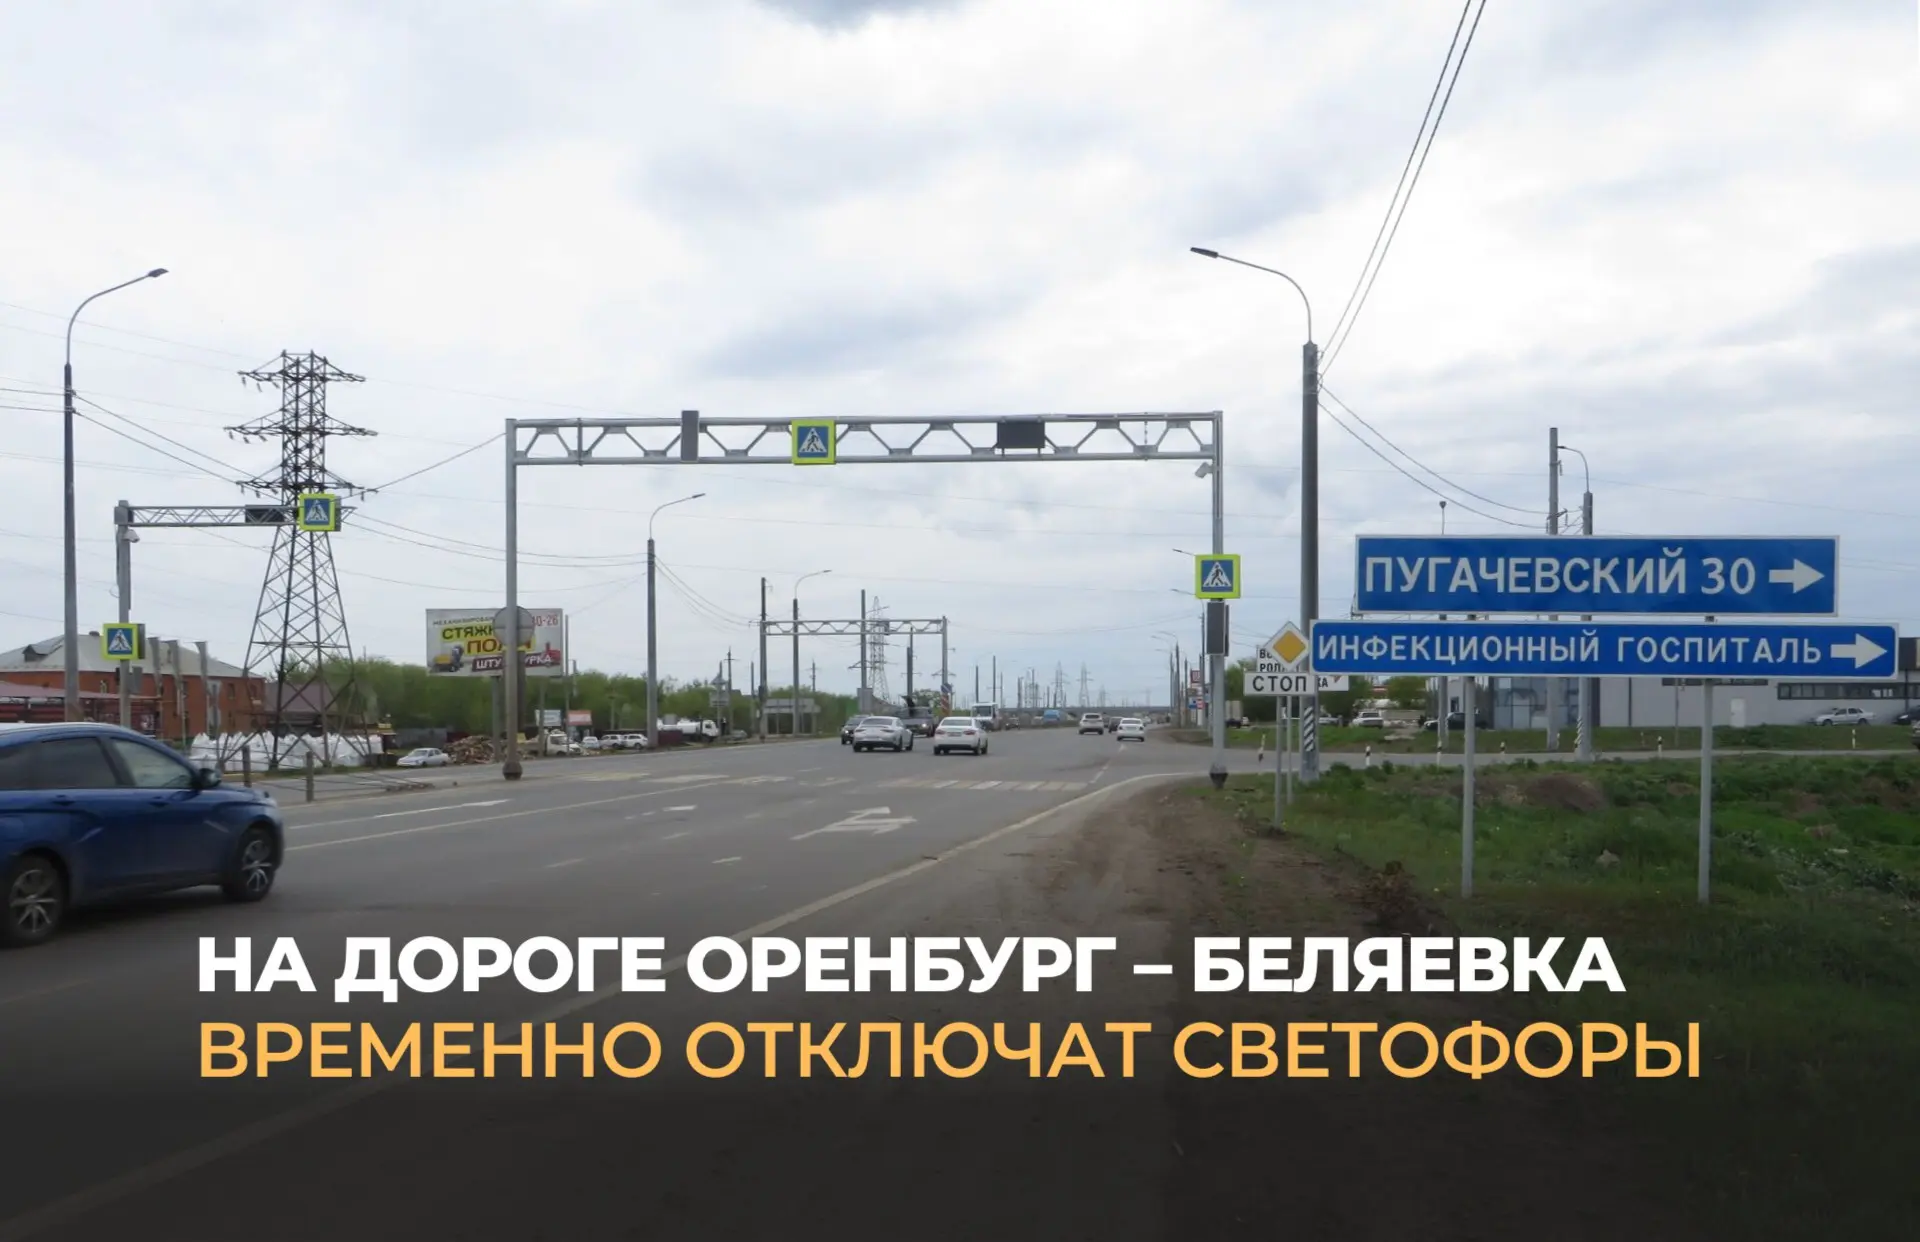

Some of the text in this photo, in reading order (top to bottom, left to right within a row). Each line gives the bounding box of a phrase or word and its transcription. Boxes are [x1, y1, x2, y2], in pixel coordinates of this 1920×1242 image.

[1365, 546, 1756, 595] ПУГАЧЕВСКИЙ 30
[1318, 629, 1822, 665] ИНФЕКЦИОННЫЙ ГОСПИТАЛЬ
[1252, 675, 1307, 692] СТОП
